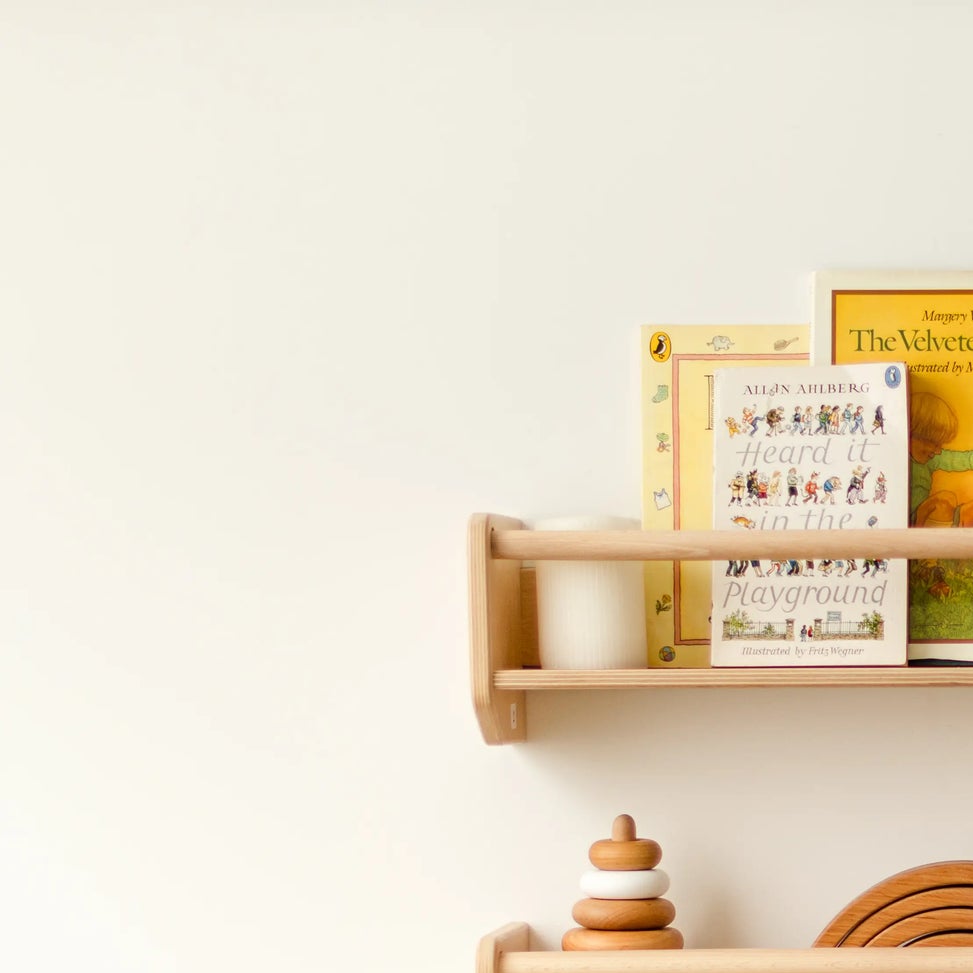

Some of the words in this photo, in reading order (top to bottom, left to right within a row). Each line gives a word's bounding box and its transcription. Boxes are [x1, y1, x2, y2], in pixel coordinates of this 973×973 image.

[922, 310, 967, 325] Margery
[849, 329, 897, 351] The
[906, 361, 949, 373] ustrated
[952, 362, 963, 376] by
[797, 383, 870, 394] AHLBERG
[735, 440, 832, 465] Heard
[847, 438, 880, 463] it
[760, 510, 788, 529] in
[800, 509, 852, 529] the
[723, 580, 888, 613] Playground
[742, 646, 791, 656] Illustrated
[795, 646, 805, 658] by
[830, 646, 865, 657] Wegner
